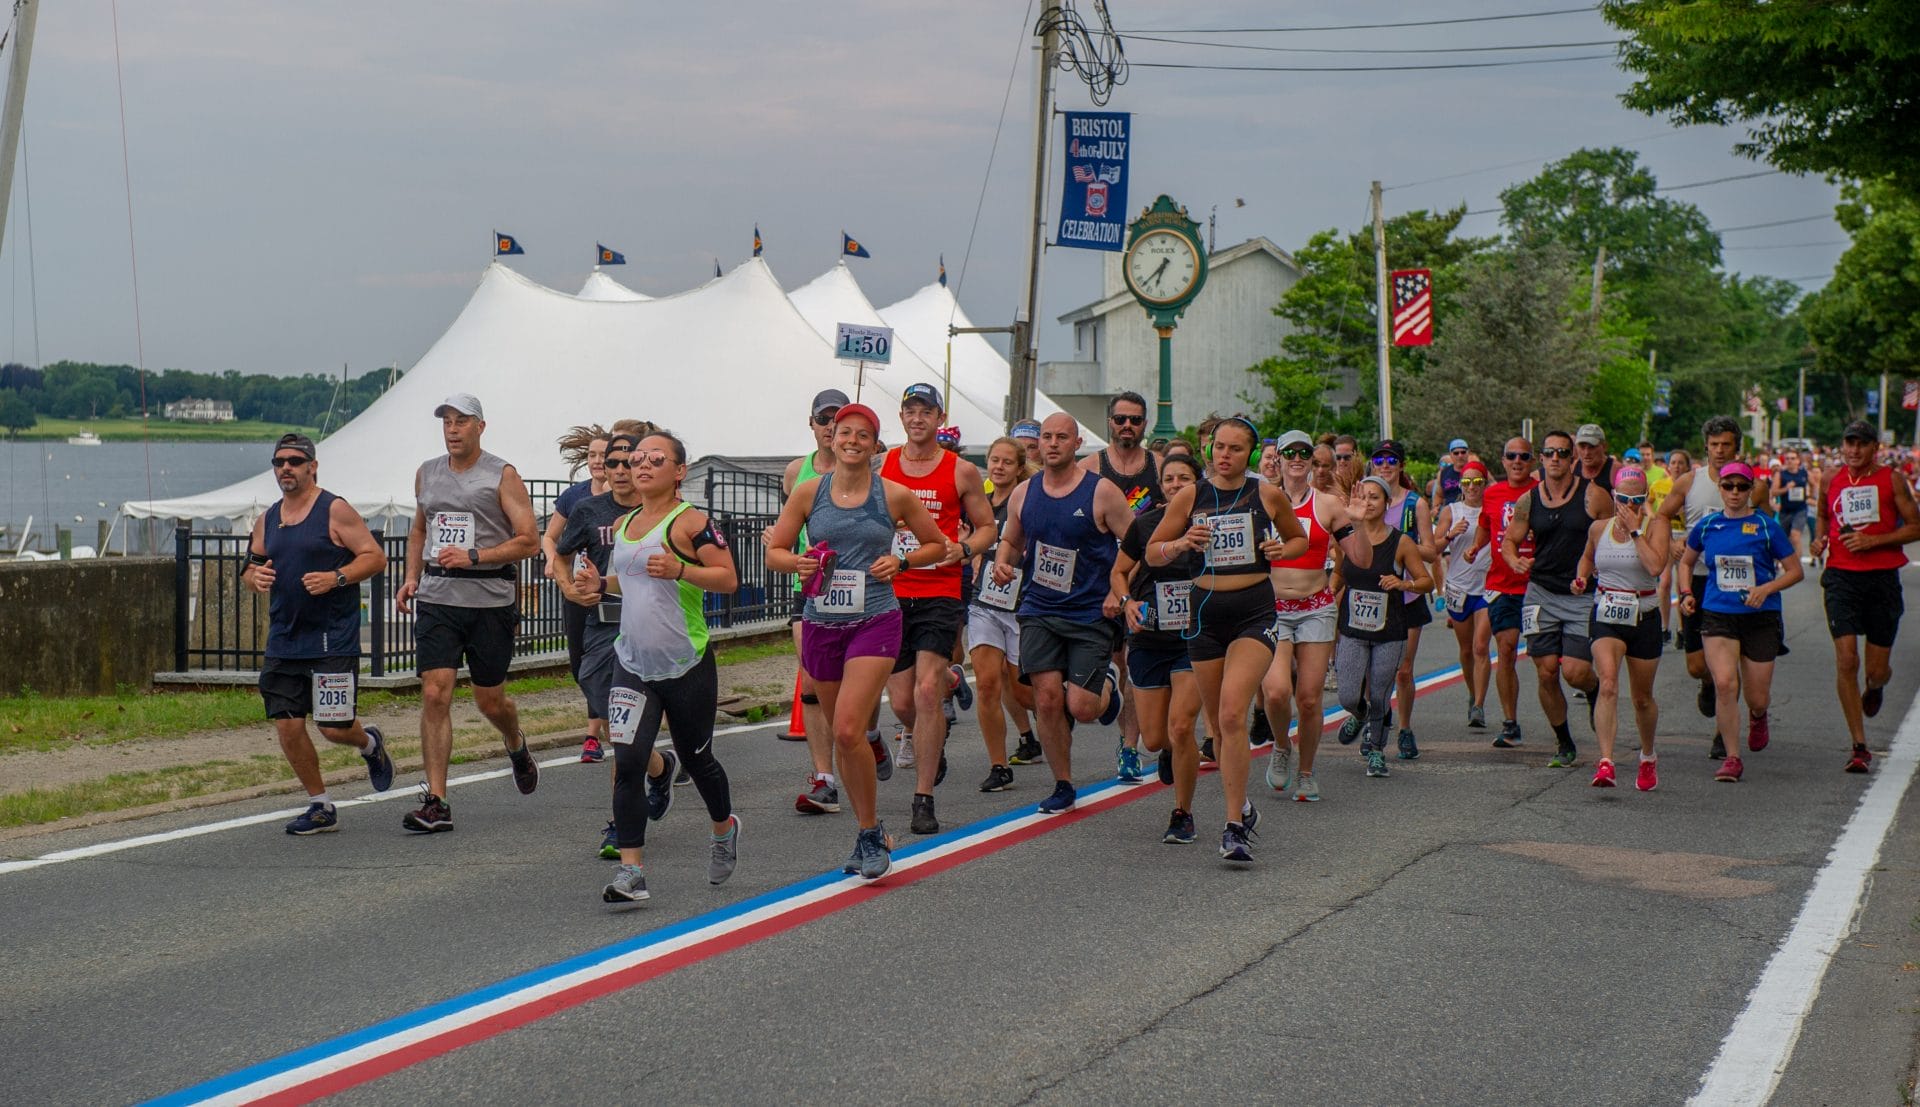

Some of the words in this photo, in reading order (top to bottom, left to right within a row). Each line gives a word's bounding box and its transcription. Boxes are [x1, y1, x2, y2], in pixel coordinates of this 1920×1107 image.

[1072, 118, 1126, 138] BRISTOL
[1097, 141, 1127, 160] JULY
[1061, 219, 1121, 243] CELEBRATION
[841, 334, 888, 355] 1:50
[1849, 499, 1872, 513] 2868
[439, 528, 466, 543] 2273
[1212, 532, 1244, 549] 2369
[1038, 557, 1065, 577] 2646
[1723, 567, 1748, 580] 2706
[822, 589, 854, 607] 2801
[1354, 603, 1380, 619] 2774
[1604, 605, 1631, 620] 2688
[319, 690, 348, 705] 2036
